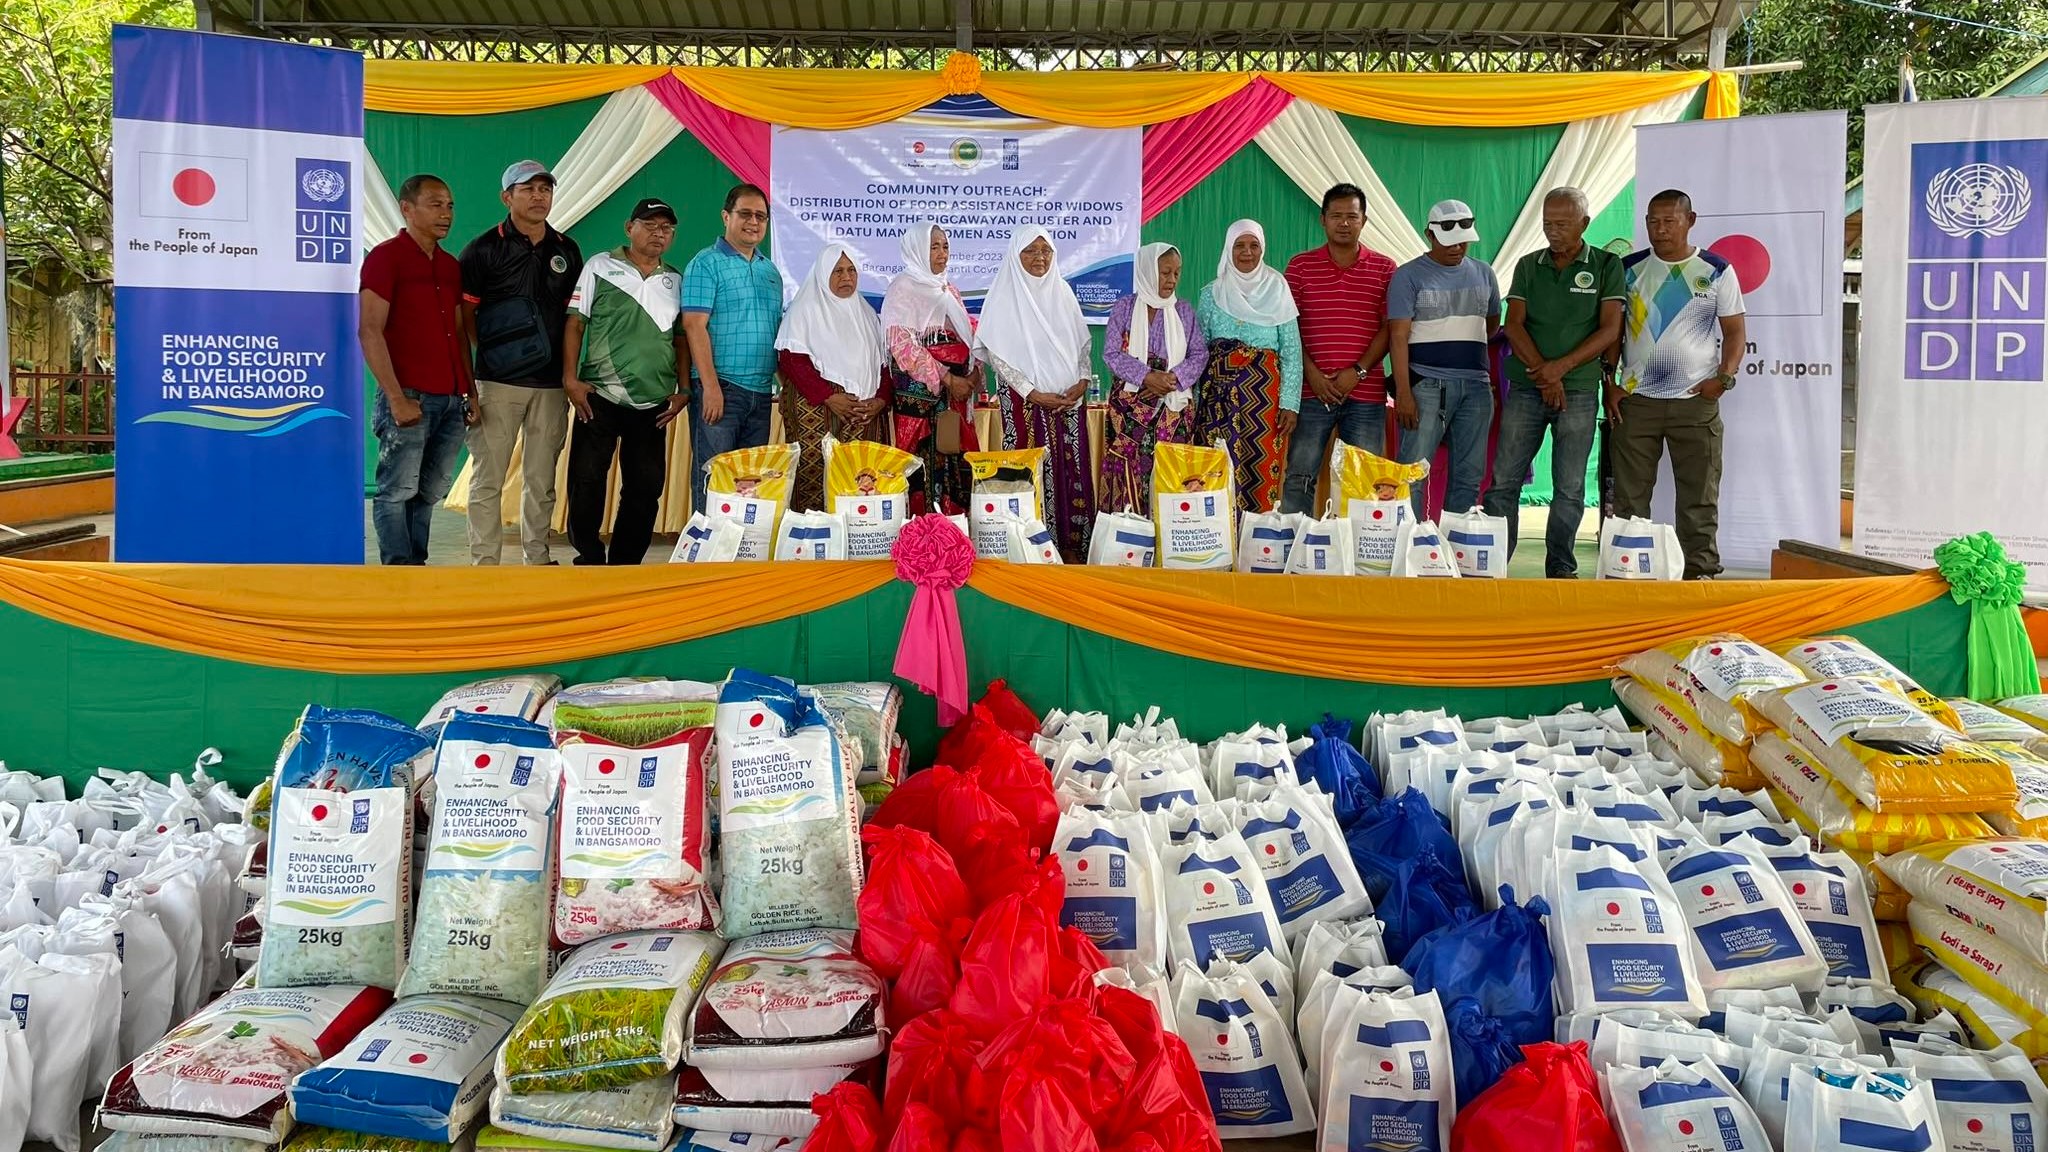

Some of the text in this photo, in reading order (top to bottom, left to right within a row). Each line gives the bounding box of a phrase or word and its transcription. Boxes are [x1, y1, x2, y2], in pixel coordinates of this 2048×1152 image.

[866, 184, 1047, 197] COMMUNITY OUTREACH:
[790, 197, 1123, 212] DISTRIBUTION OF FOOD ASSISTANCE FOR WIDOWS
[800, 212, 818, 221] OF
[821, 212, 852, 222] WAR
[855, 213, 894, 223] FROM
[1021, 216, 1079, 225] CLUSTER
[1083, 216, 1112, 226] AND
[178, 228, 211, 240] From
[836, 227, 871, 237] DATU
[944, 229, 982, 239] OMEN
[129, 240, 258, 257] the People of Japan
[978, 253, 1003, 261] 2023
[973, 266, 999, 274] Cove
[162, 334, 279, 349] ENHANCING
[162, 351, 326, 367] FOOD SECURITY
[1746, 360, 1832, 379] of Japan
[161, 368, 307, 384] & LIVELIHOOD
[162, 385, 324, 400] IN BANGSAMORO
[732, 753, 790, 769] ENHANCING
[732, 760, 812, 779] FOOD SECURITY
[733, 771, 803, 789] & LIVELIHOOD
[733, 780, 814, 799] IN BANGSAMORO
[446, 798, 507, 807] ENHANCING
[444, 808, 528, 818] FOOD SECURITY
[577, 806, 640, 816] ENHANCING
[443, 818, 517, 828] & LIVELIHOOD
[577, 816, 662, 826] FOOD SECURITY
[847, 777, 864, 877] HARVEST QUALITY
[442, 828, 527, 838] IN BANGSAMORO
[575, 827, 651, 836] & LIVELIHOOD
[575, 838, 661, 846] IN BANGSAMORO
[760, 843, 801, 854] Net Weight
[289, 853, 353, 863] ENHANCING
[288, 864, 376, 873] FOOD SECURITY
[760, 858, 803, 876] 25kg
[287, 873, 364, 883] & LIVELIHOOD
[286, 884, 375, 894] IN BANGSAMORO
[1953, 876, 2006, 910] Sarap sa Lodi
[465, 917, 491, 925] Weight
[570, 911, 597, 925] 25kg
[751, 911, 781, 920] GOLDEN
[794, 915, 823, 923] Kudarat
[298, 928, 343, 946] 25kg
[1208, 930, 1240, 939] ENHANCING
[1226, 933, 1253, 942] SECURITY
[1720, 926, 1756, 938] ENHANCING
[1723, 929, 1772, 943] FOOD SECURITY
[447, 929, 491, 950] 25kg
[1731, 934, 1769, 947] LIVELIHOOD
[1941, 931, 1995, 972] Lodi sa Sarap
[429, 983, 460, 991] GOLDEN
[398, 1025, 468, 1044] ENHANCING
[440, 1027, 472, 1039] FOOD
[528, 1039, 555, 1050] NET
[615, 1026, 644, 1038] 25kg
[248, 1071, 282, 1082] SUPER
[232, 1078, 286, 1091] DENORADO
[1239, 1090, 1269, 1099] SECURITY
[1372, 1114, 1407, 1122] ENHANCING
[1378, 1127, 1417, 1135] LIVELIHOOD
[1391, 1122, 1423, 1130] SECURITY
[1380, 1134, 1422, 1142] BANGSAMORO
